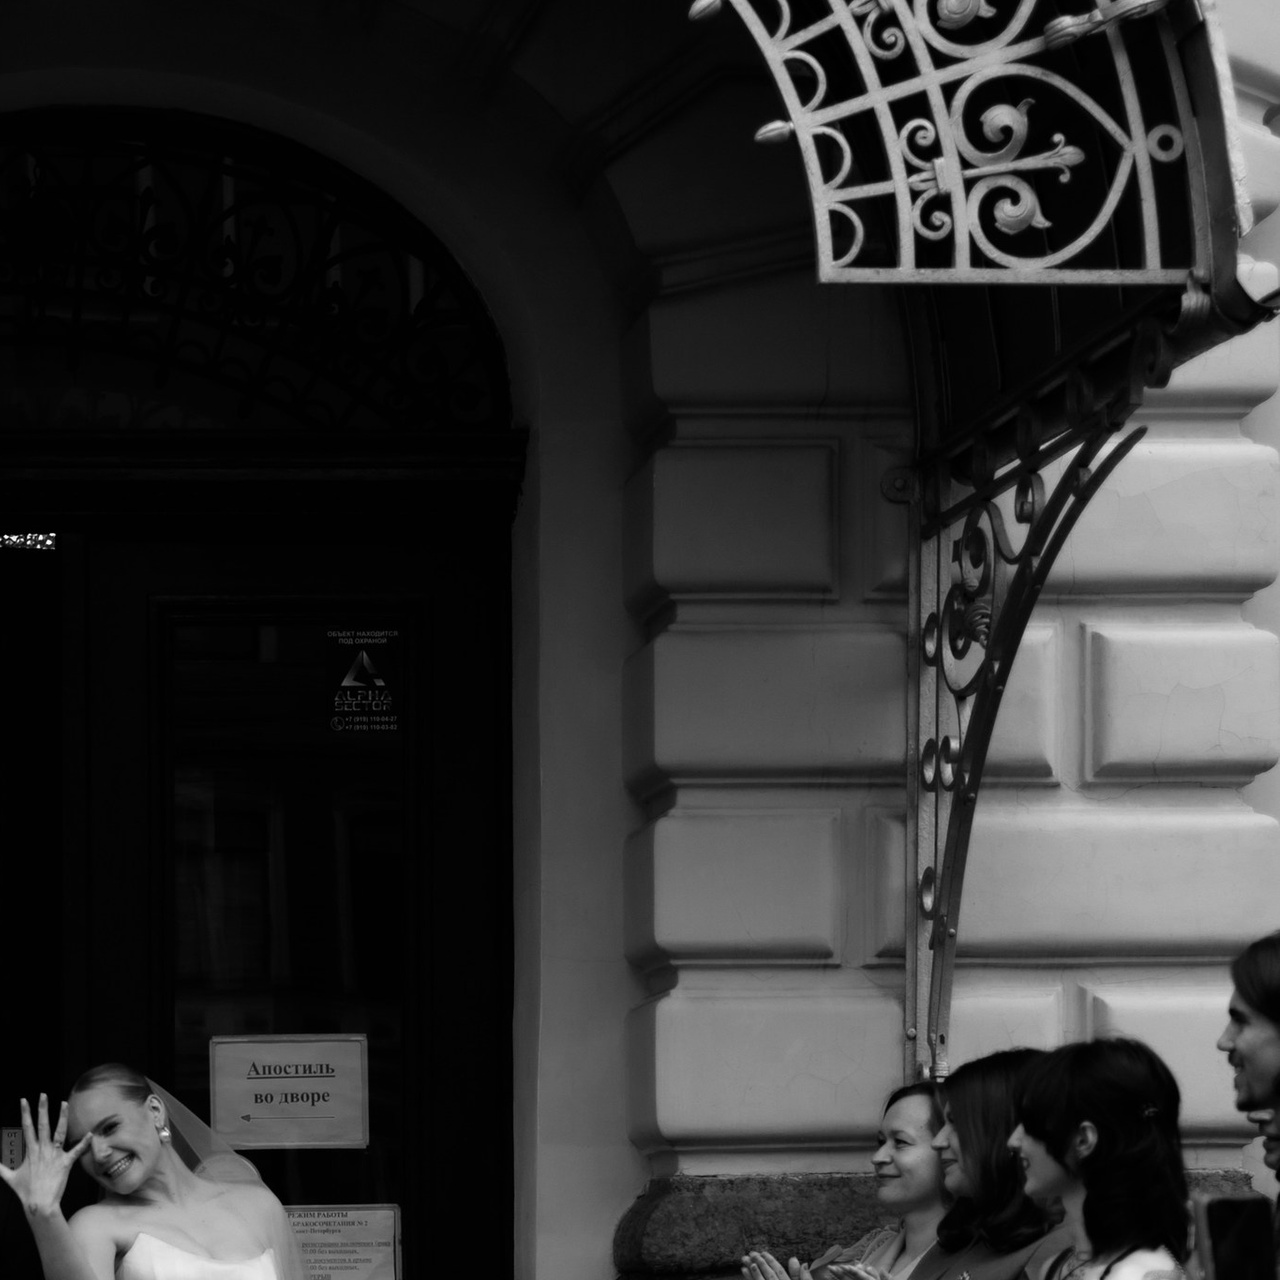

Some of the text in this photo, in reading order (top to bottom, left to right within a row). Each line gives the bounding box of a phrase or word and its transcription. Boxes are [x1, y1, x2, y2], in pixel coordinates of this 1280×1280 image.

[334, 690, 392, 700] ALPHA
[334, 701, 392, 711] SECTOR
[247, 1061, 336, 1076] Апостиль
[254, 1091, 330, 1107] во дворе
